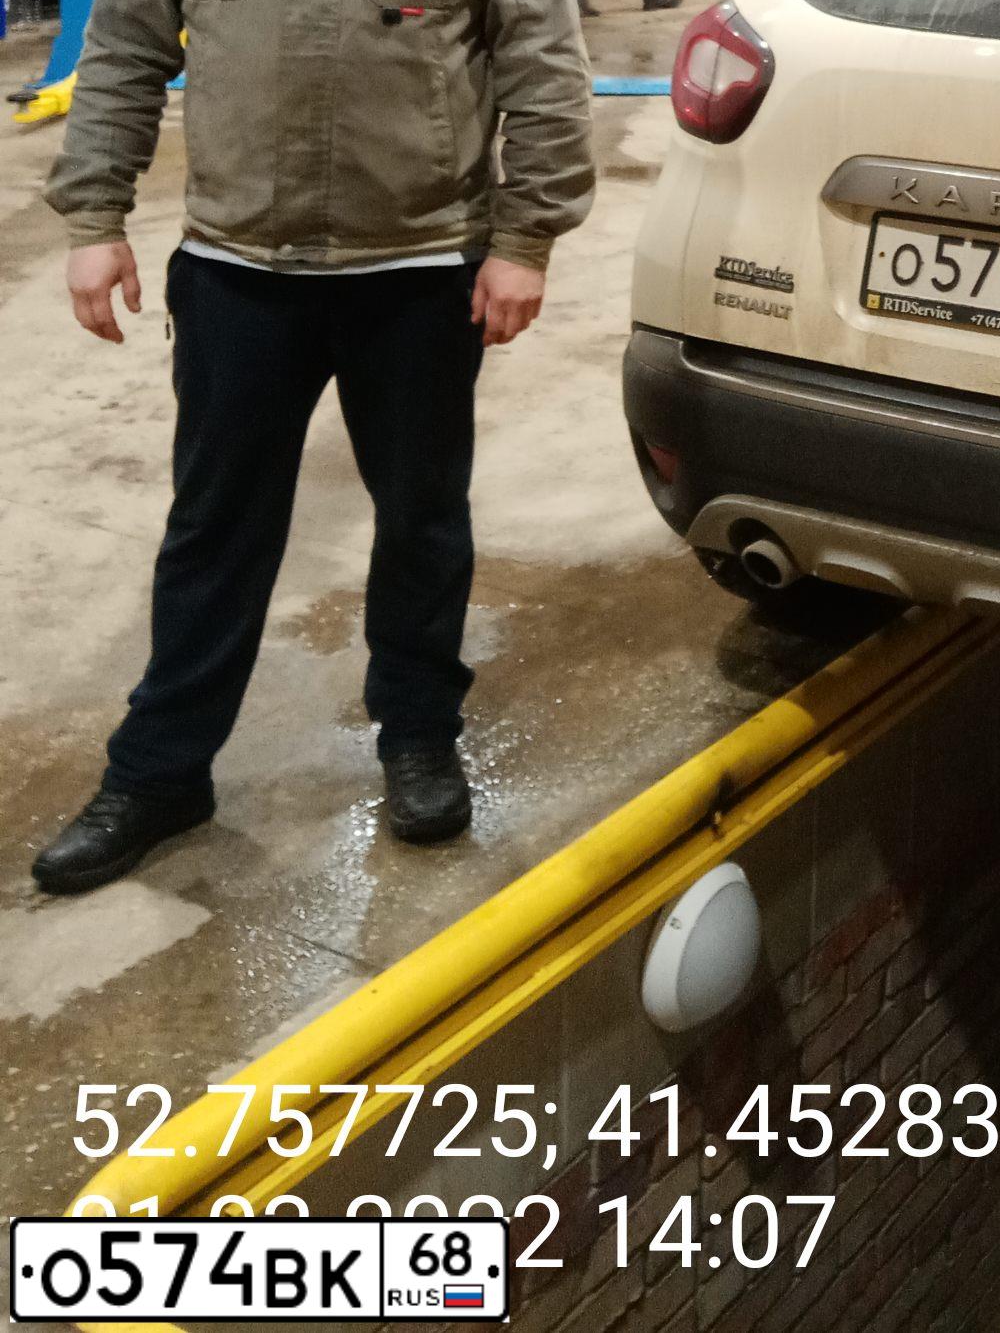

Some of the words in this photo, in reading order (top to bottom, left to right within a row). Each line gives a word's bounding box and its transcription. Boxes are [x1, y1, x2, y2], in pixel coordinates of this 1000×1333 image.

[714, 292, 793, 320] RENAULT
[883, 296, 953, 322] RTDService
[970, 313, 984, 327] +7
